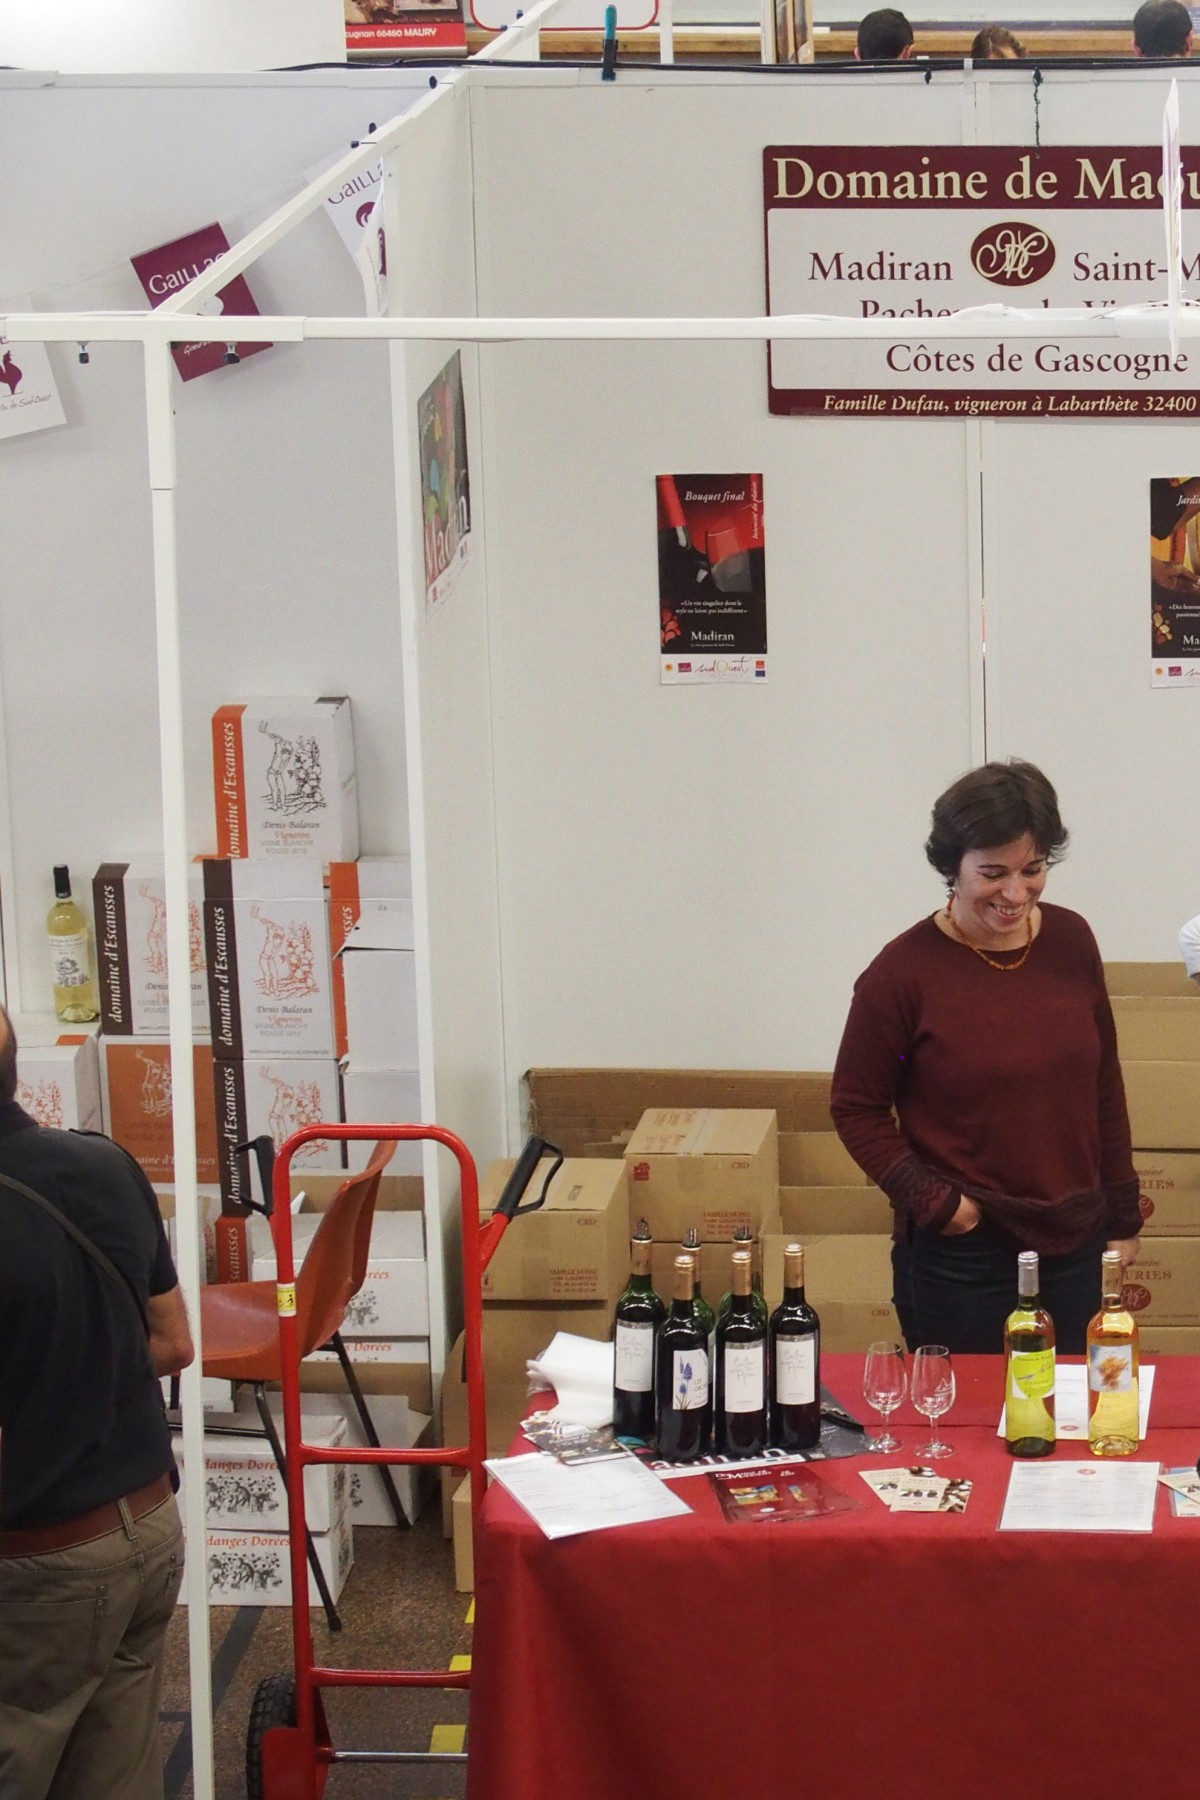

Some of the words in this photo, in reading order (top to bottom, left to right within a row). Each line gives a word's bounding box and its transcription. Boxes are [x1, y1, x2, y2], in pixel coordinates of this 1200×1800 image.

[376, 29, 403, 37] 66460
[404, 28, 437, 37] MAURY
[773, 157, 988, 200] Domaine
[1005, 157, 1058, 200] de
[809, 251, 953, 281] Madiran
[886, 345, 975, 373] Côtes
[987, 343, 1023, 373] de
[1034, 344, 1189, 380] Gascogne
[824, 394, 886, 410] Famille
[891, 394, 949, 414] Dufau,
[954, 396, 1027, 415] vigneron
[1032, 395, 1042, 411] à
[1047, 395, 1138, 411] Labarthète
[1143, 396, 1196, 411] 32400
[685, 491, 721, 503] Bouquet
[721, 491, 745, 503] final
[691, 630, 734, 641] Madiran
[223, 722, 238, 799] d'Escausses
[103, 885, 118, 961] d'Escausses
[213, 907, 230, 985] d'Escausses
[108, 964, 123, 1023] domaine
[217, 987, 233, 1046] domaine
[223, 1067, 239, 1145] d'Escausses
[1140, 1180, 1174, 1189] RIES
[1125, 1270, 1172, 1280] URIES
